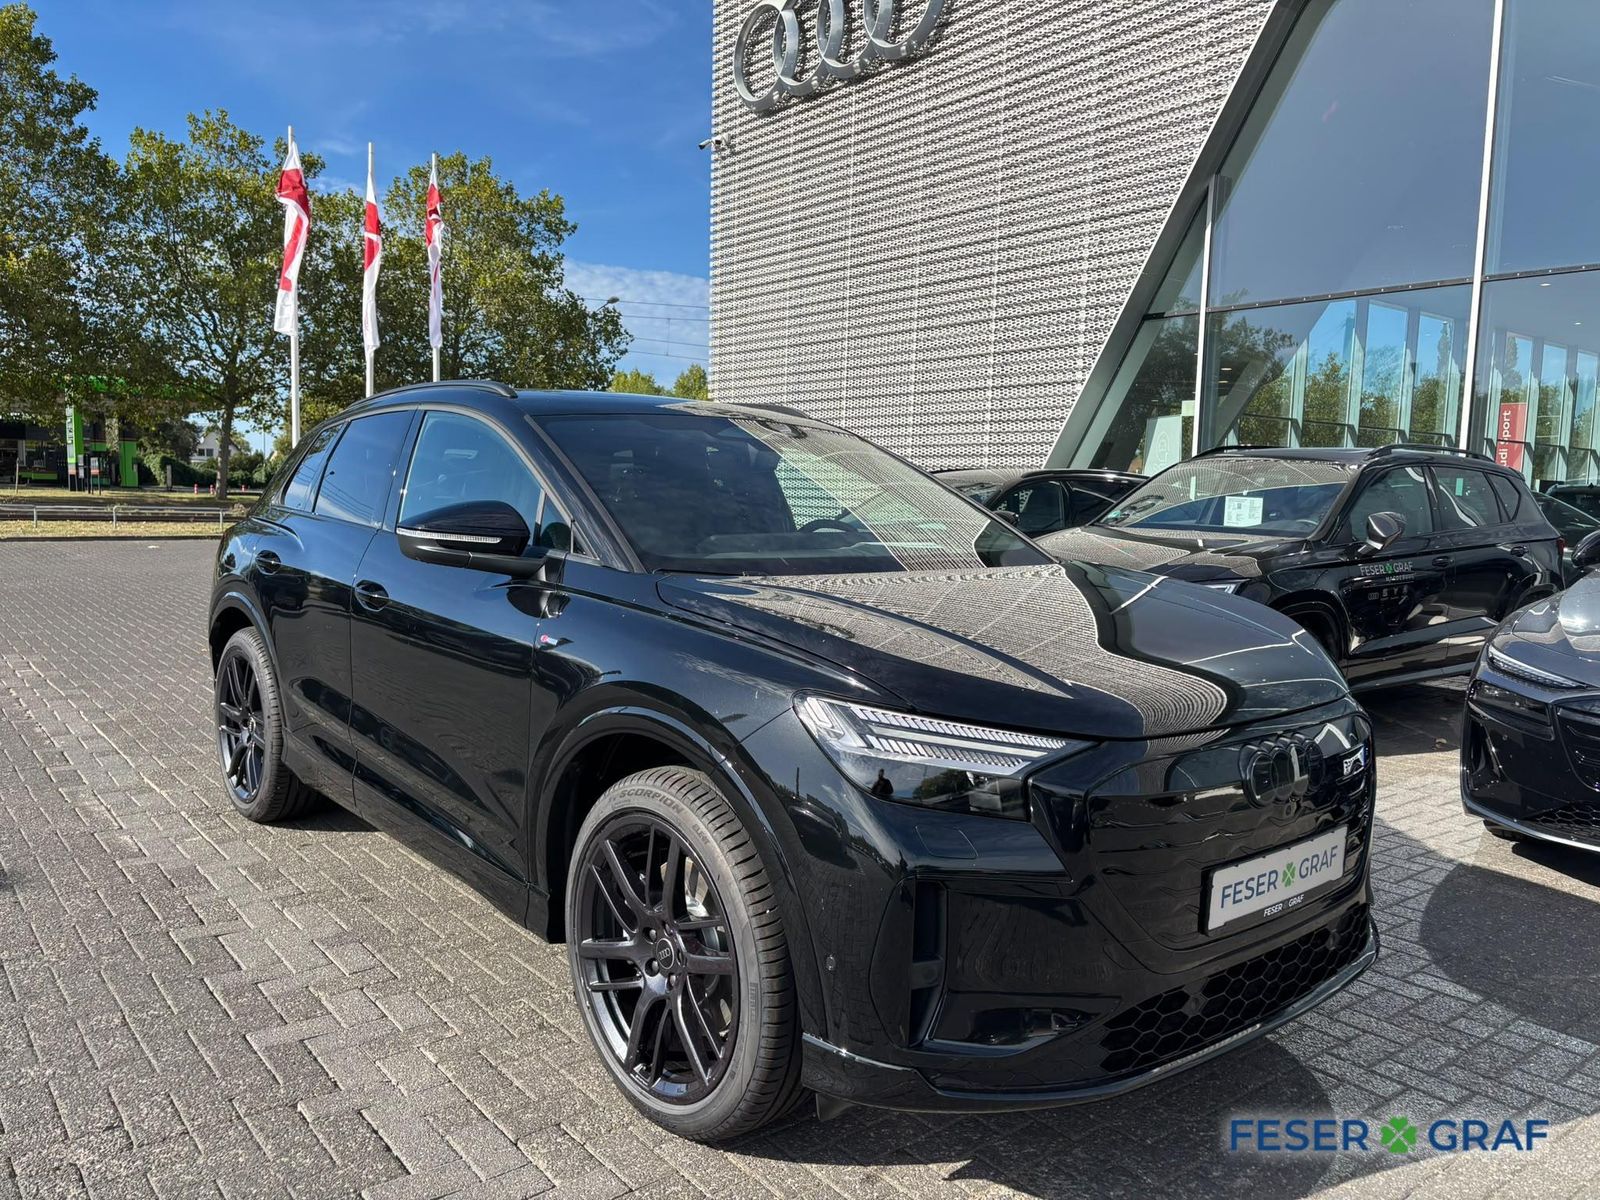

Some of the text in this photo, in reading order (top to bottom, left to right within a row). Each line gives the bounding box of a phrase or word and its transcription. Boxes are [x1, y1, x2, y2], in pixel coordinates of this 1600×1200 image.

[1360, 561, 1413, 576] FESER GRAF
[619, 788, 685, 815] SCORPION
[1220, 845, 1338, 909] FESER GRAF
[1263, 894, 1305, 917] FESER GRAF
